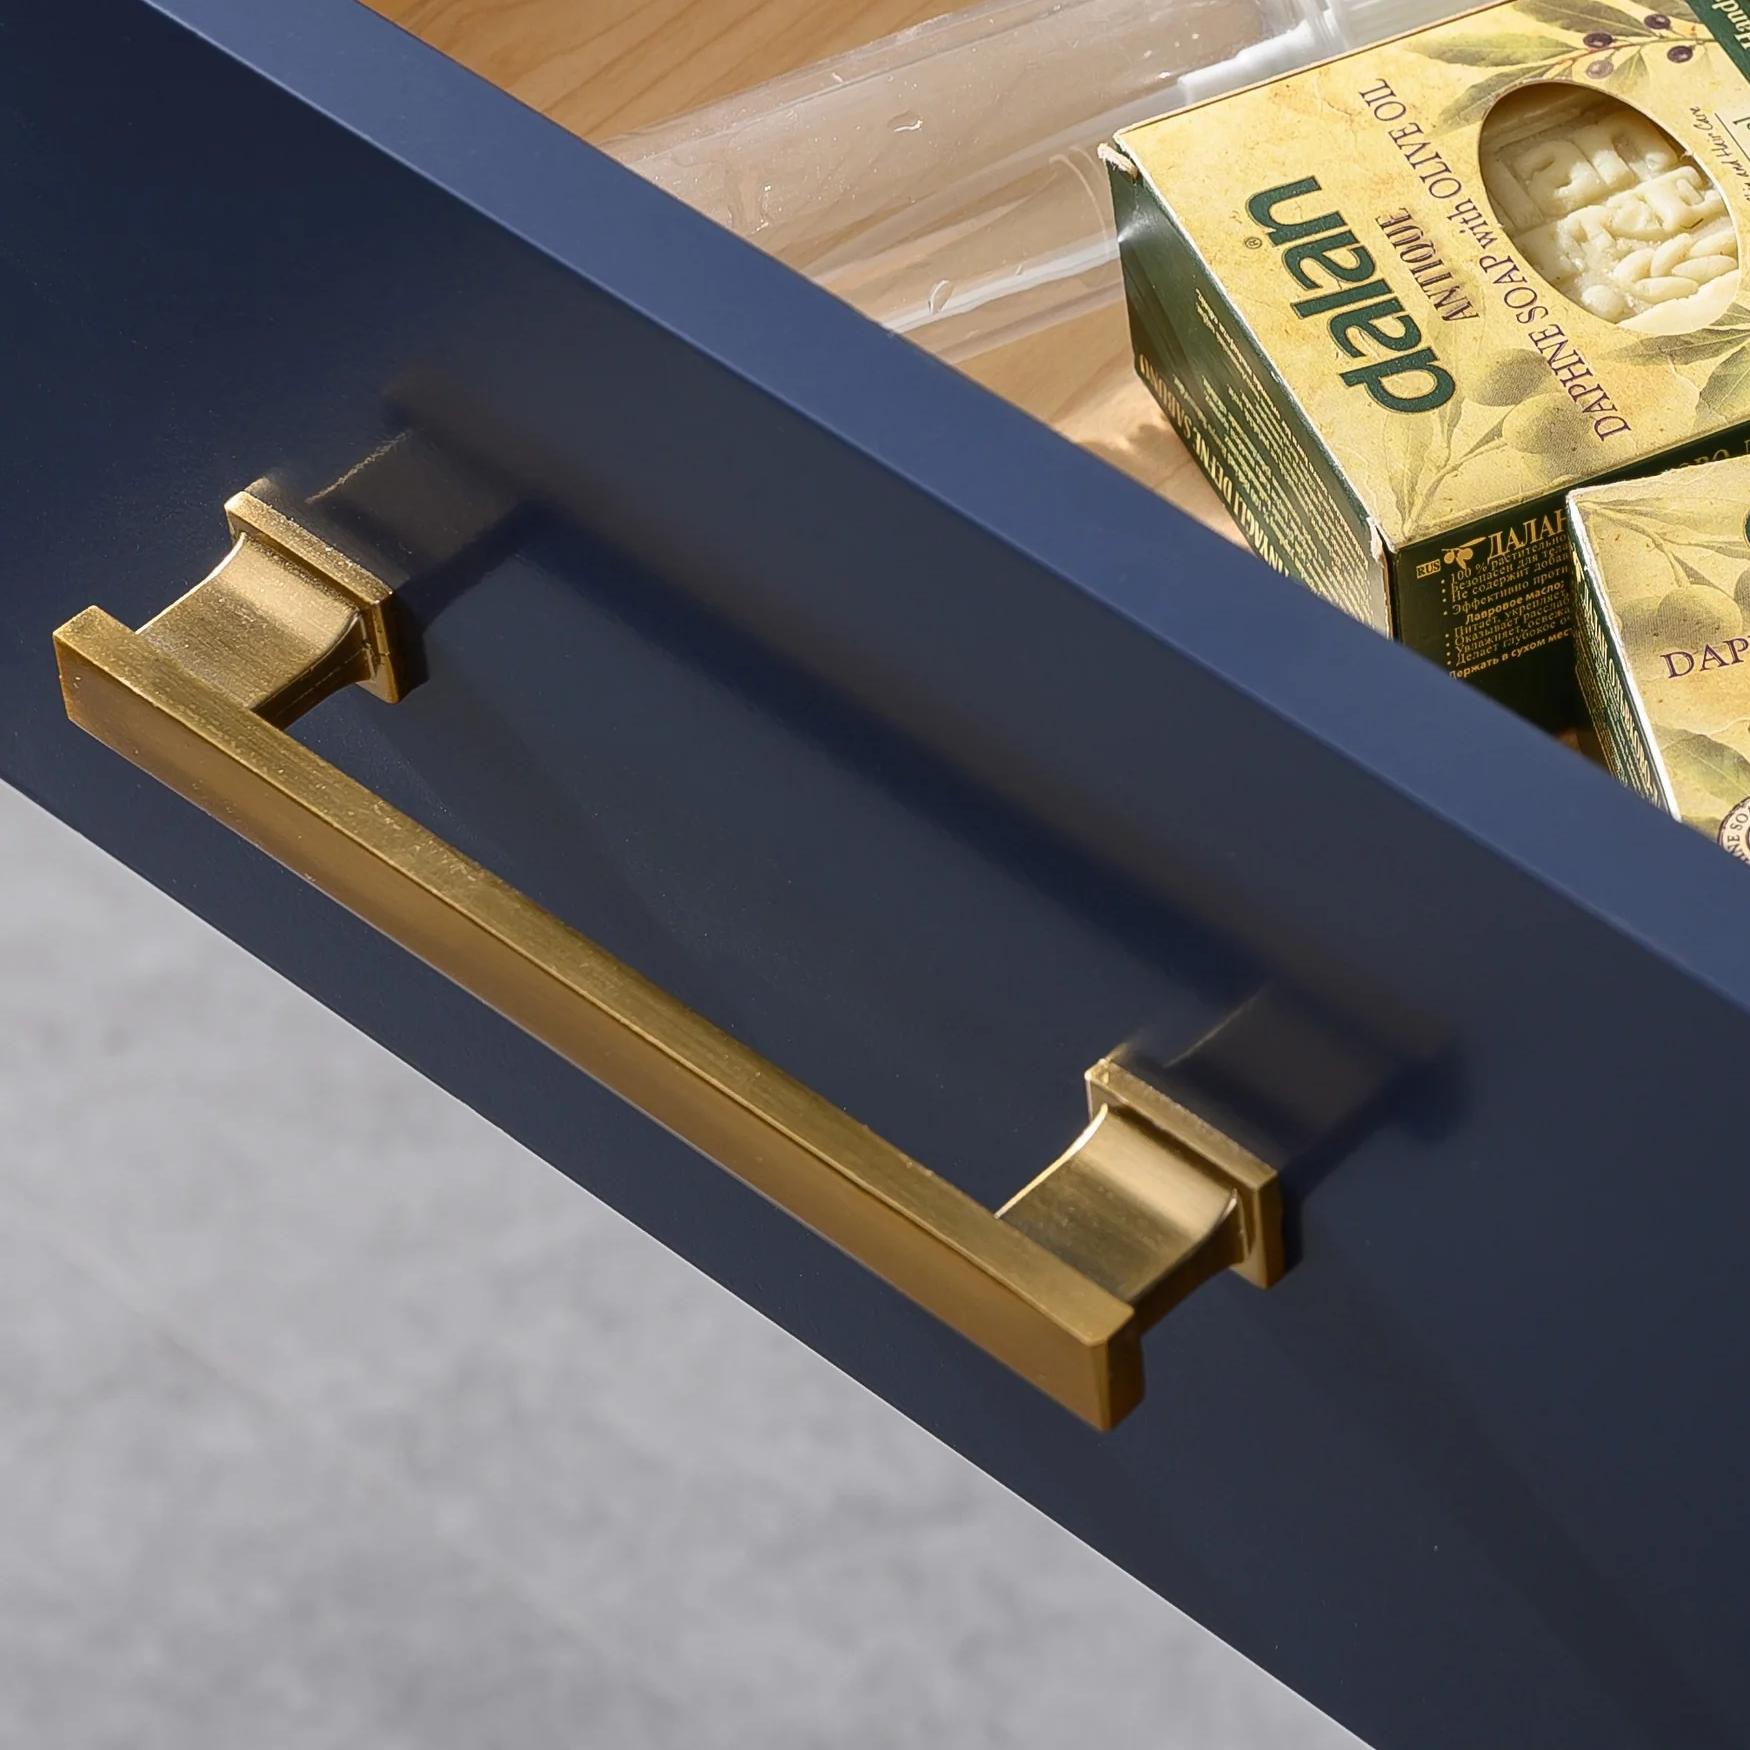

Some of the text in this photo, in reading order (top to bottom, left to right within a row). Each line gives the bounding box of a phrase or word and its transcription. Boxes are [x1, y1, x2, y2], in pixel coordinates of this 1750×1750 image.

[1358, 78, 1407, 122] OIL
[1689, 106, 1714, 131] Care
[1388, 122, 1462, 199] OLIVE
[1708, 132, 1733, 158] Hair
[1721, 160, 1749, 178] and
[1446, 198, 1498, 250] with
[1375, 208, 1480, 322] ANTIQUE
[1479, 255, 1549, 324] SOAP
[1244, 175, 1457, 415] dalan
[1528, 324, 1632, 442] DAPHNE
[1416, 558, 1441, 579] RUS
